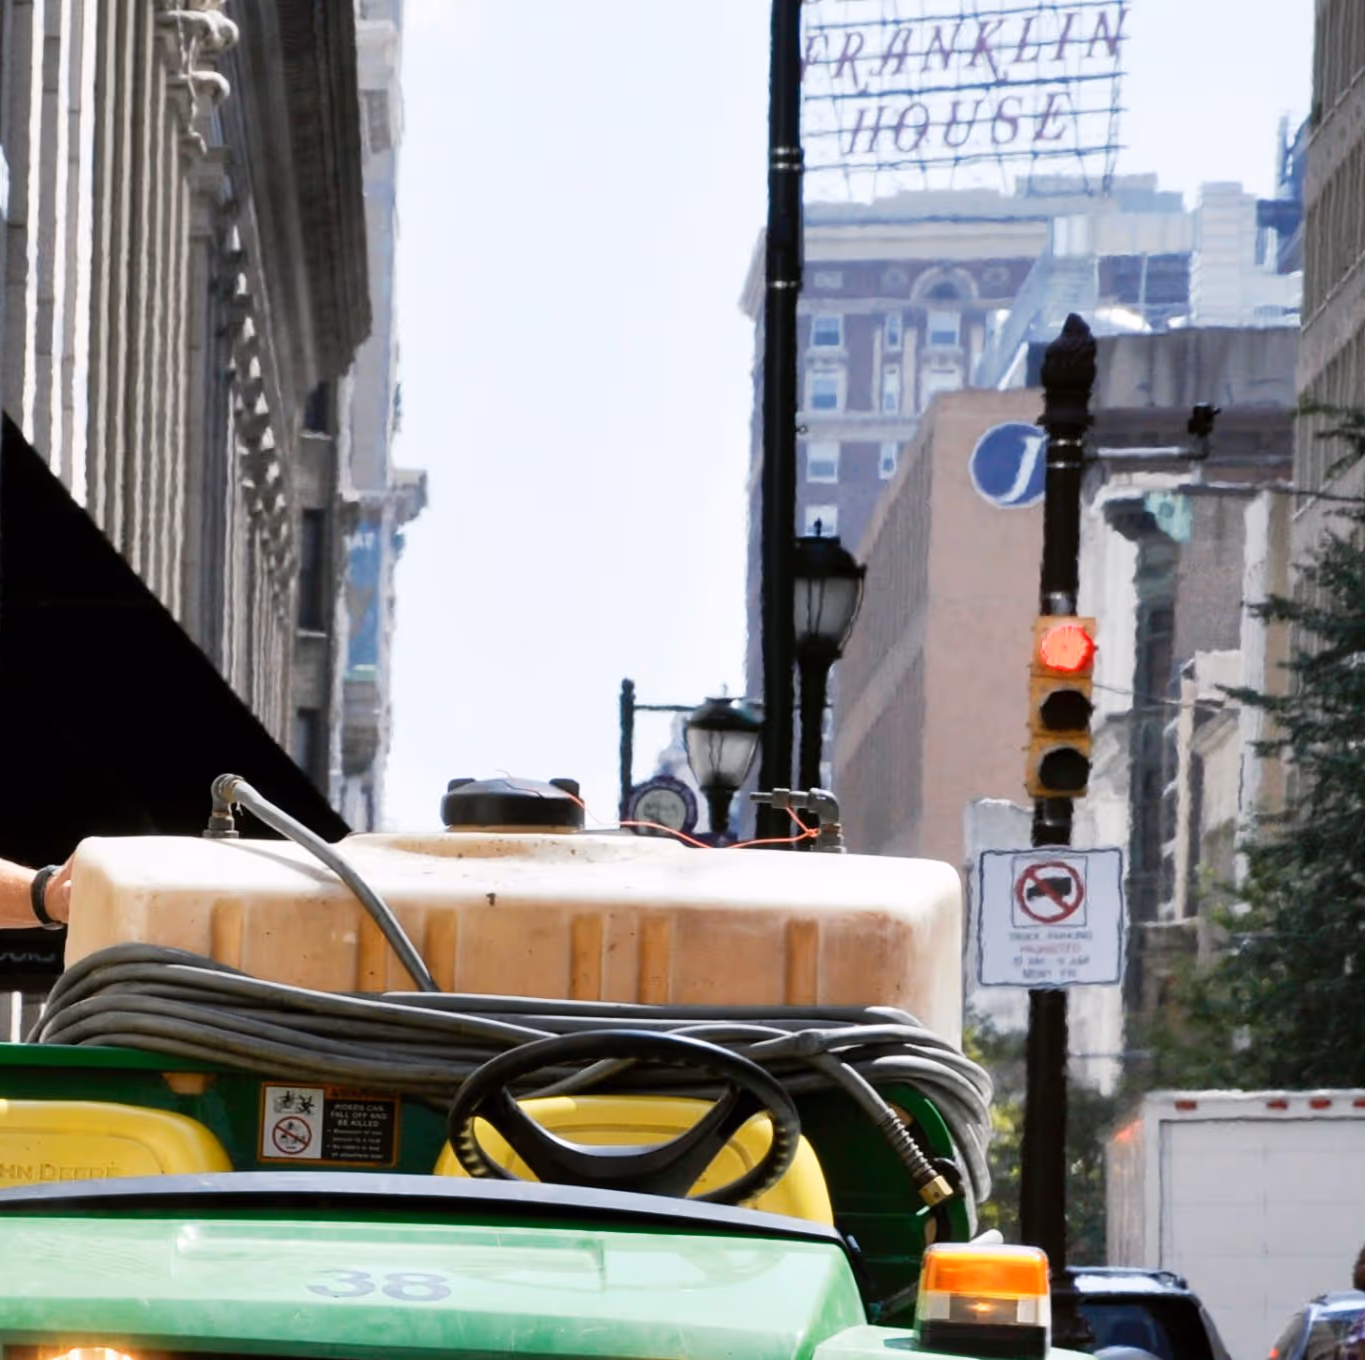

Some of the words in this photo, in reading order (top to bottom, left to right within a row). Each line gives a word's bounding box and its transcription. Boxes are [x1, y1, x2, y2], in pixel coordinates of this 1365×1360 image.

[801, 9, 1130, 96] FRANKLIN
[843, 92, 1072, 154] HOUSE
[306, 1269, 452, 1302] 38
